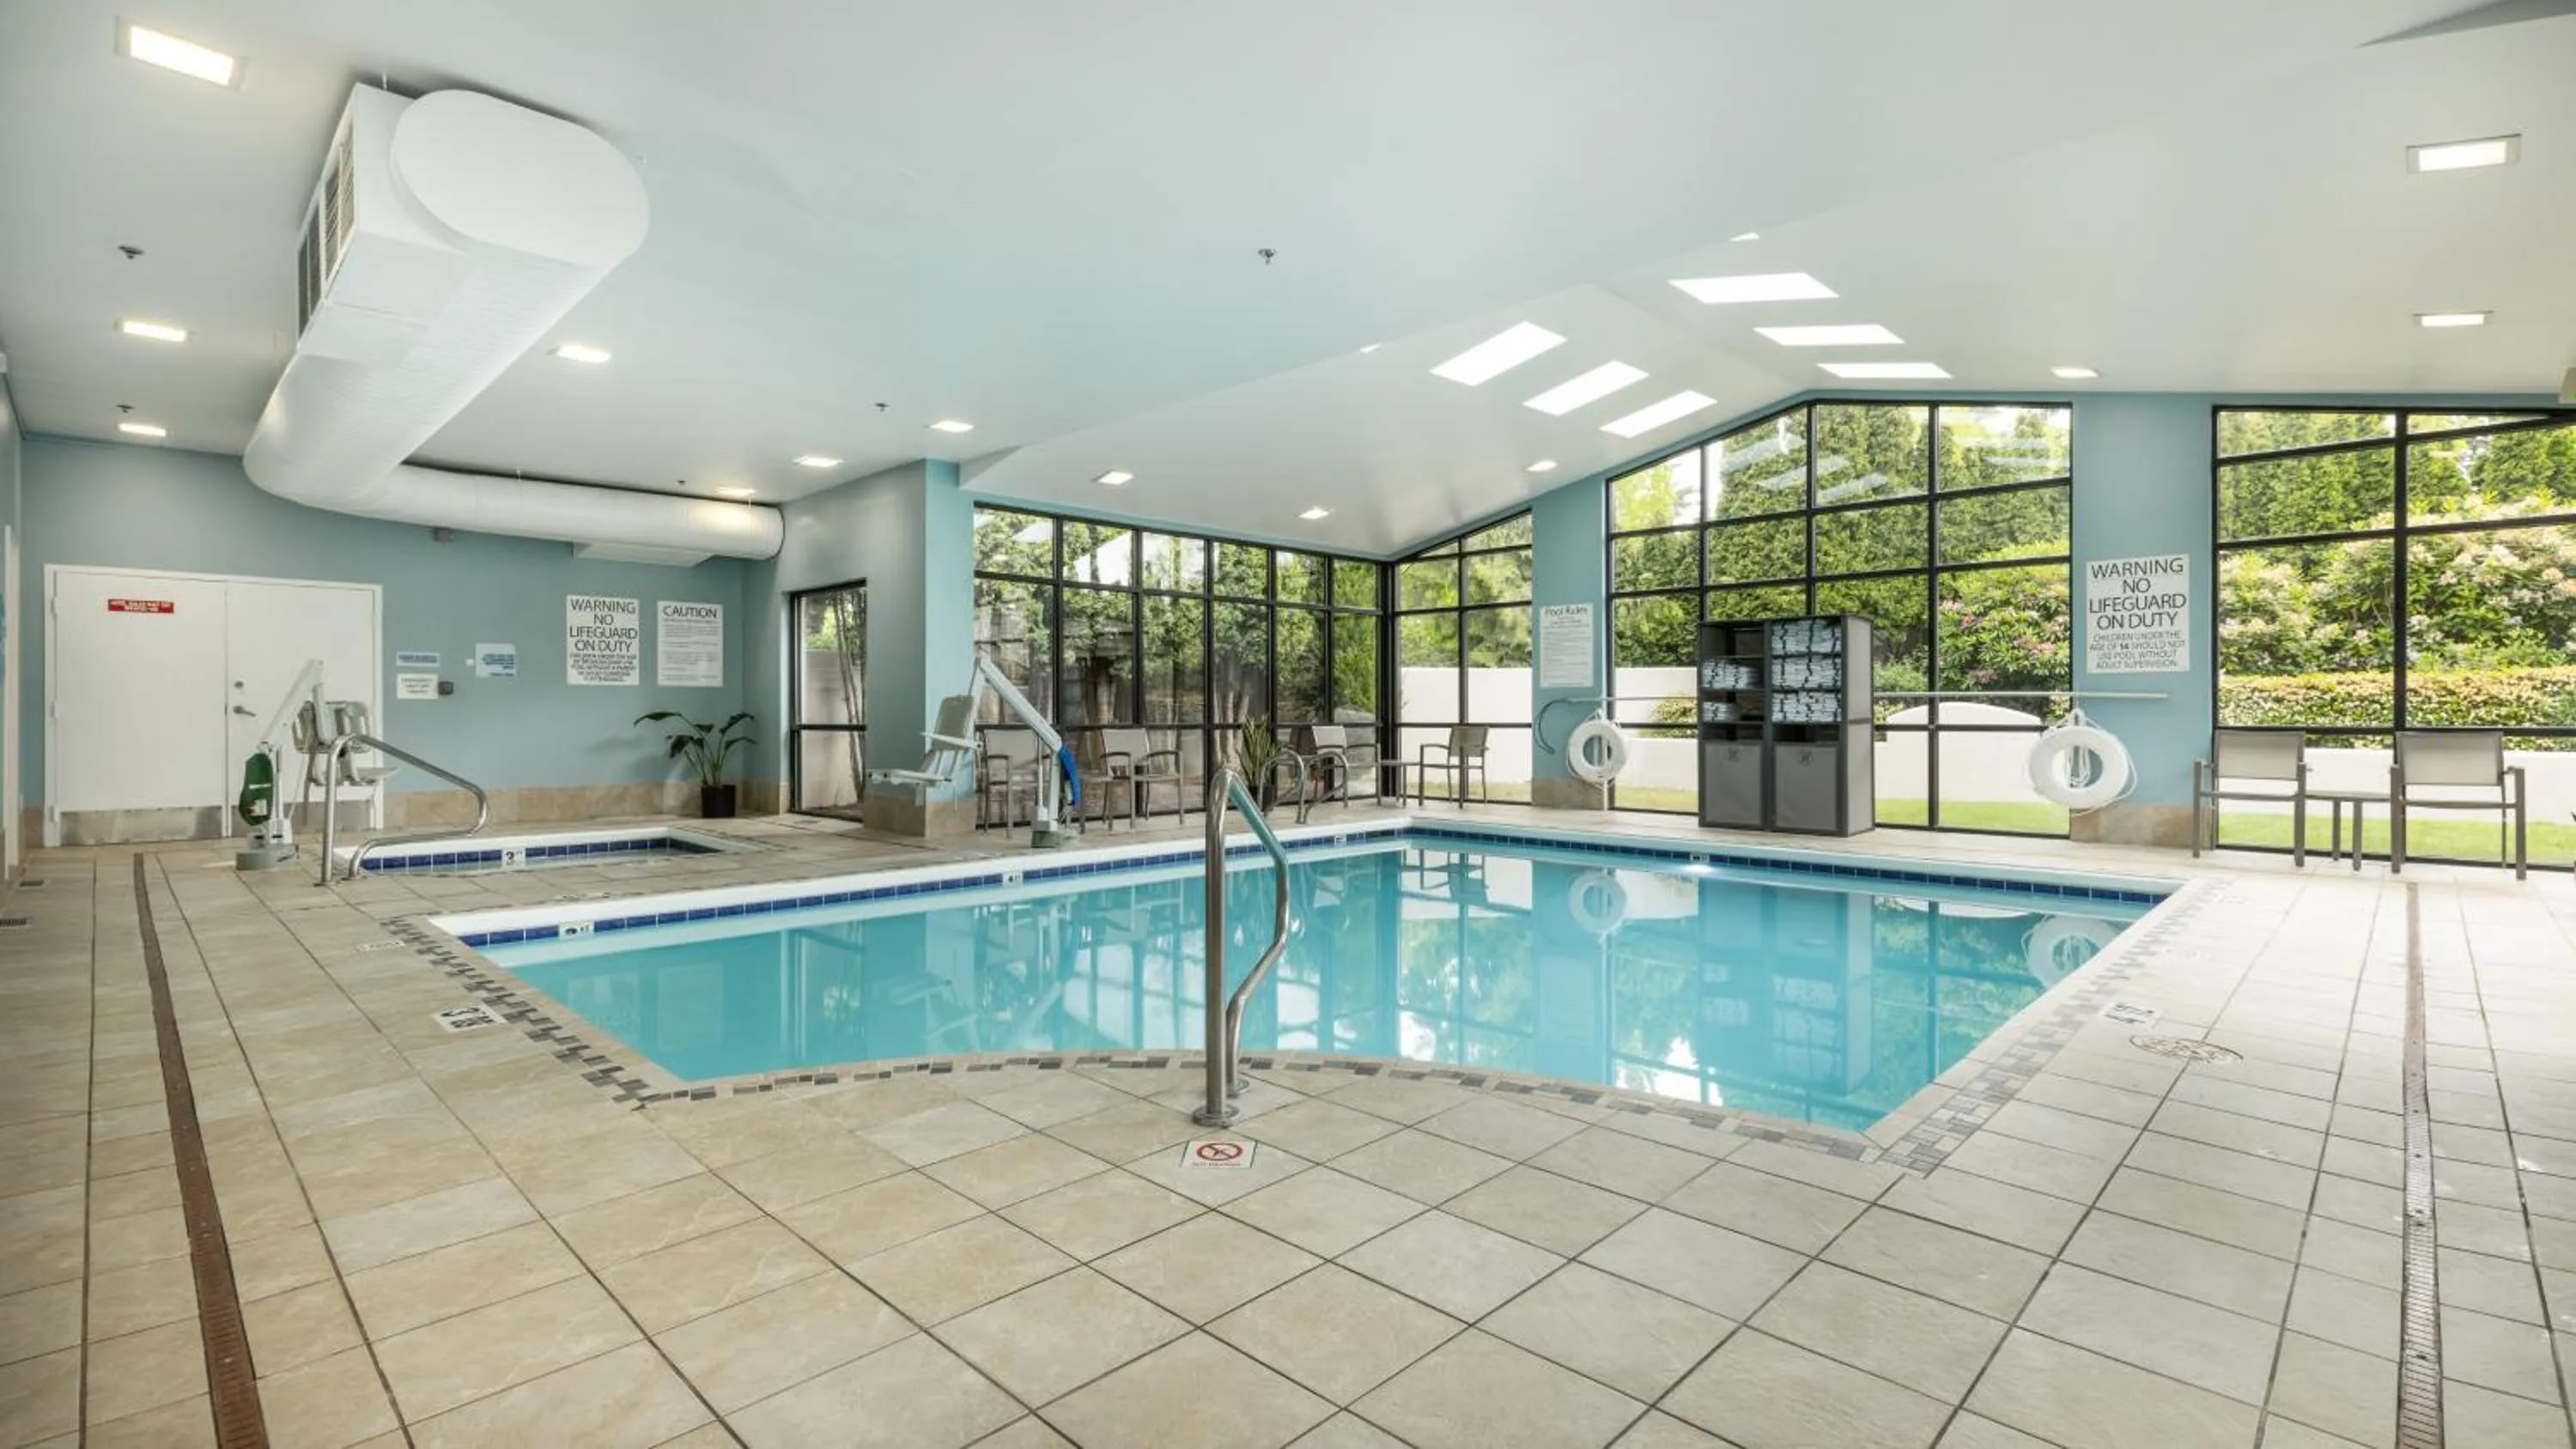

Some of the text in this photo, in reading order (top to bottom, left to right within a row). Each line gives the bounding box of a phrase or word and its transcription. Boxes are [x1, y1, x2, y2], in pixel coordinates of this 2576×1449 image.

[2092, 558, 2184, 579] WARNING
[2123, 579, 2151, 594] NO
[570, 599, 636, 614] WARNING
[2089, 594, 2187, 614] LIFEGUARD
[663, 605, 718, 619] CAUTION
[593, 615, 614, 625] NO
[2096, 611, 2178, 630] ON DUTY
[569, 627, 638, 640] LIFEGUARD
[2093, 630, 2181, 642] CHILDREN UNDER THE
[574, 640, 632, 653] ON DUTY
[2106, 642, 2117, 651] OF
[2131, 640, 2166, 650] SHOULD
[2168, 640, 2185, 648] NOT
[2114, 651, 2136, 659] POOL
[2138, 649, 2177, 658] WITHOUT
